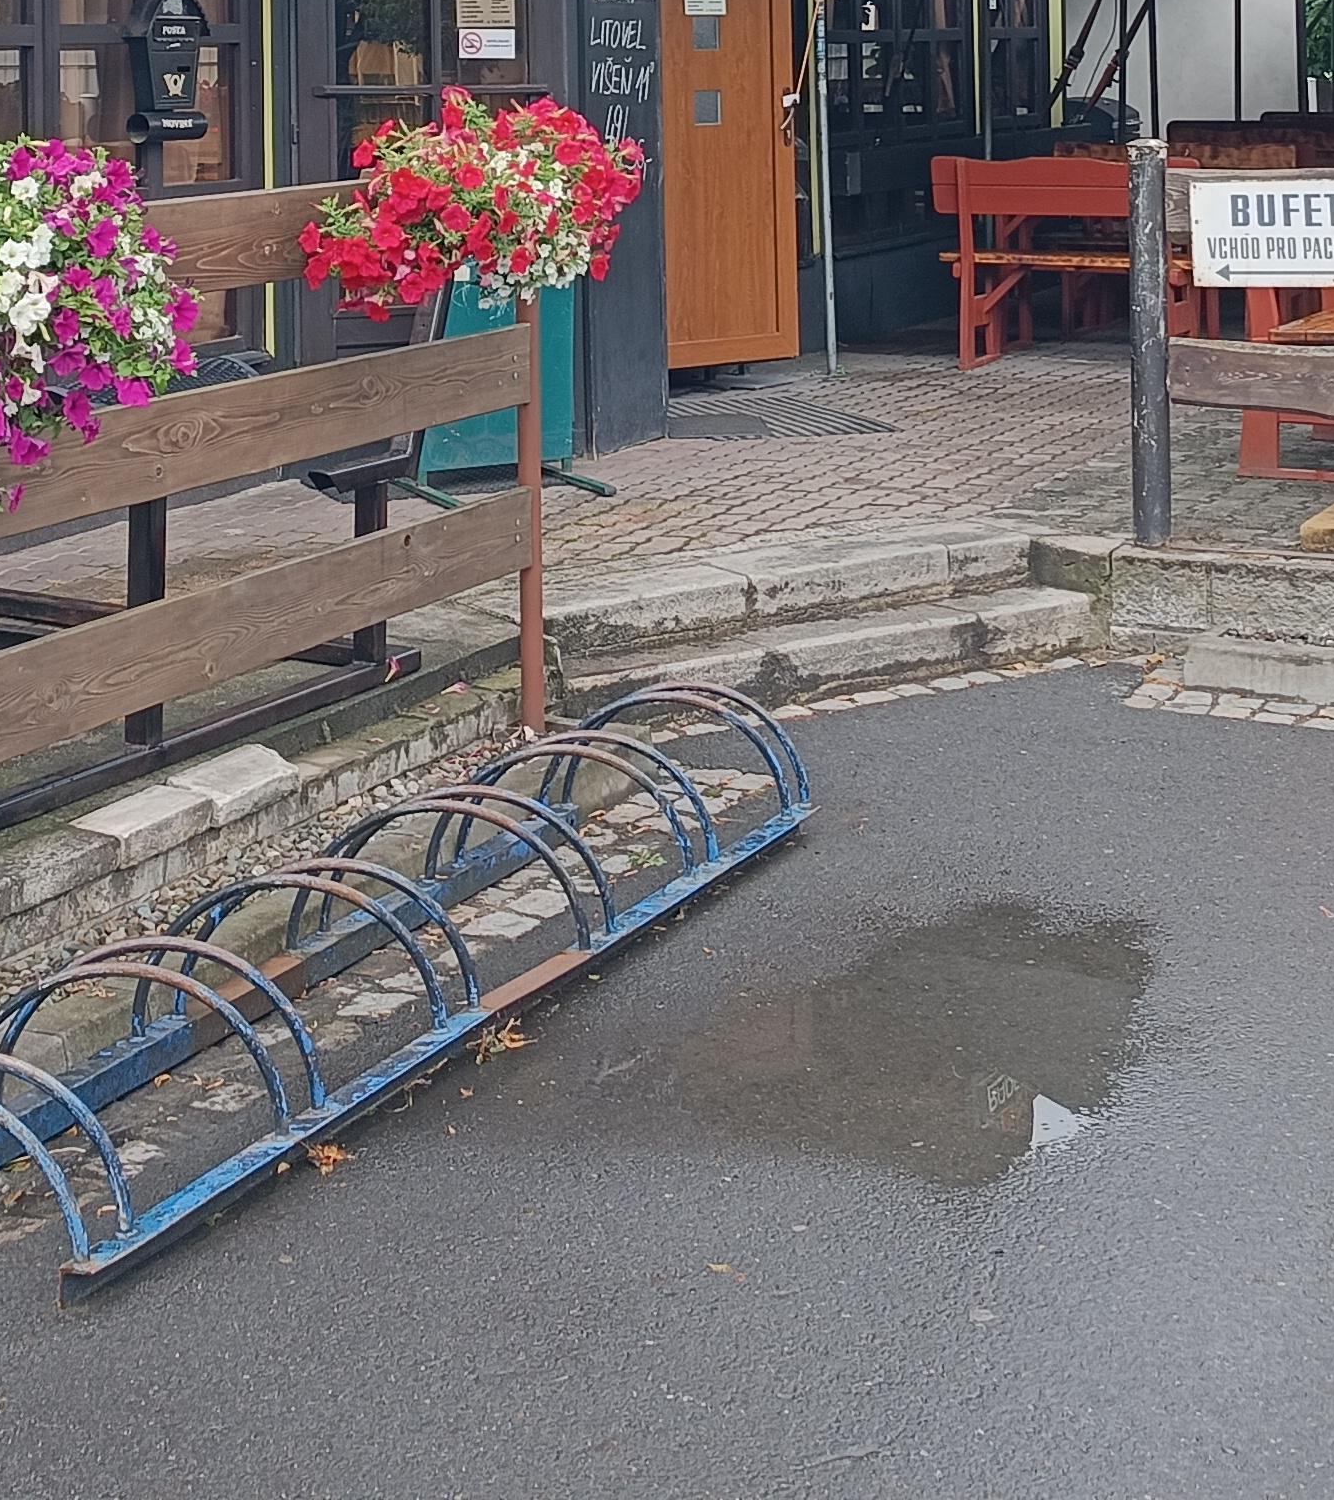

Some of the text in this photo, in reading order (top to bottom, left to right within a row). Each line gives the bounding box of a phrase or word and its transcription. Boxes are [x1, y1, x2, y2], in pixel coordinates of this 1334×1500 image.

[590, 16, 647, 50] LITOVEL
[591, 56, 633, 95] VIŠEŇ
[1267, 236, 1298, 260] PRO
